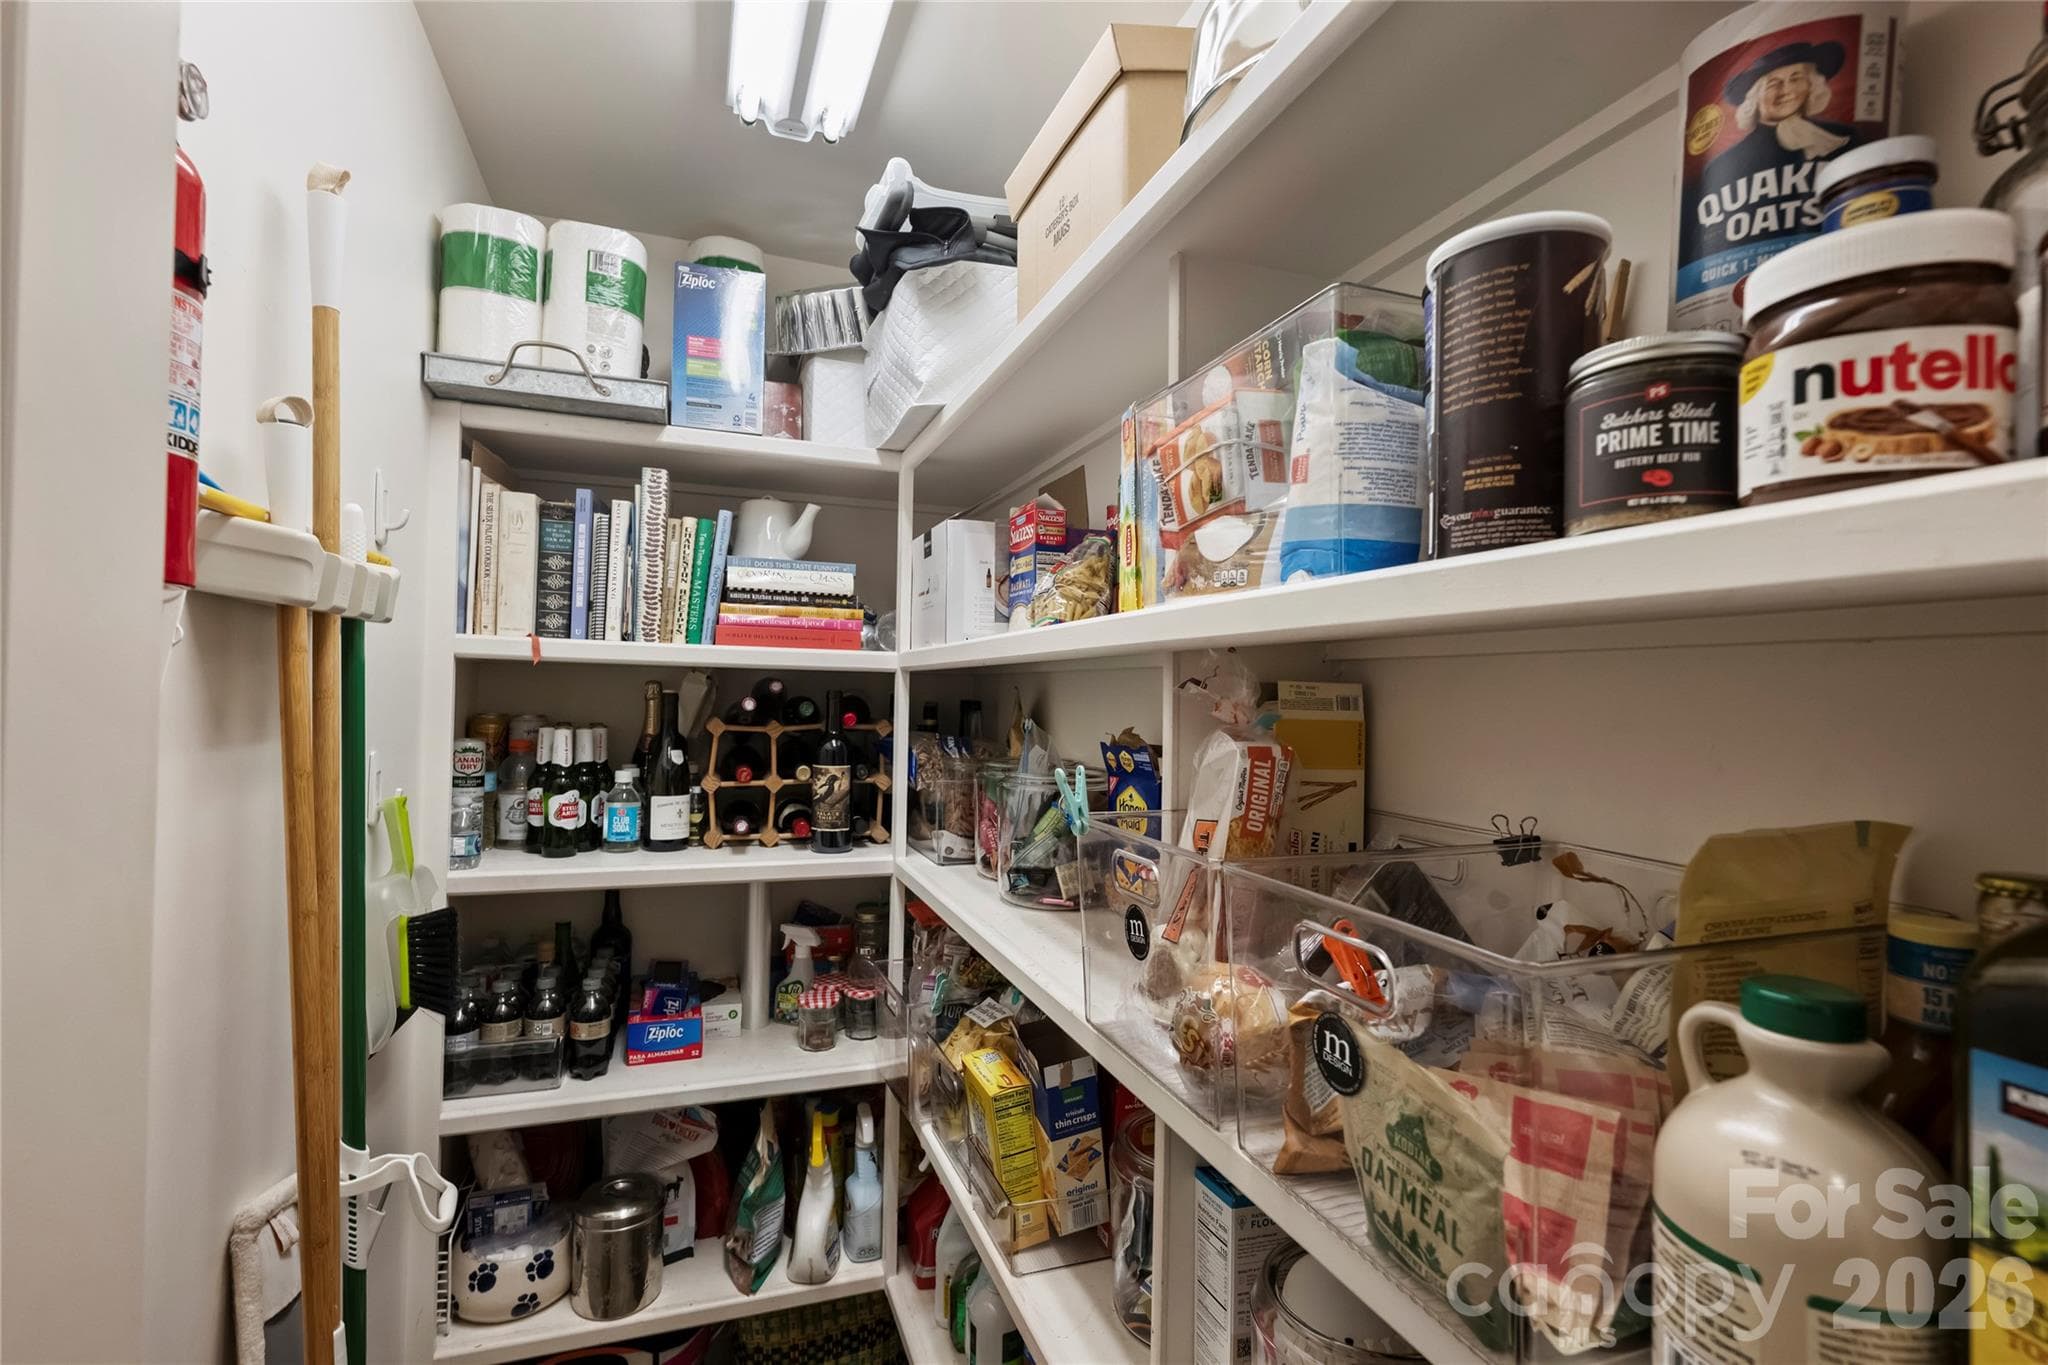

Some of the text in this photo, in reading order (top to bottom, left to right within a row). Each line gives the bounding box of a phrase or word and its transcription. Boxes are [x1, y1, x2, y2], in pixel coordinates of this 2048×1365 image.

[1697, 161, 1831, 227] QUAK
[1726, 198, 1827, 241] OATS
[680, 272, 717, 289] Ziploc
[1701, 260, 1737, 283] QUICK
[1262, 341, 1273, 380] CORN
[1600, 401, 1716, 430] Butchers Blend
[1596, 421, 1720, 456] PRIME TIME
[1614, 455, 1655, 469] BUTTERY
[1657, 452, 1680, 464] BEEF
[483, 546, 491, 578] COOKBOOK
[610, 503, 621, 600] SOUTHERN COOKING
[688, 579, 702, 631] MASTERS
[1246, 759, 1272, 832] ORIGINAL
[505, 809, 527, 820] ZER
[613, 816, 630, 825] CLUB
[1120, 818, 1140, 831] Maid
[612, 825, 630, 833] SODA
[1923, 987, 1942, 1007] 15
[648, 1024, 684, 1042] Ziploc
[647, 1049, 684, 1058] ALMACENAR
[1323, 1030, 1352, 1067] m
[1322, 1052, 1353, 1077] DESIGN
[1055, 1112, 1097, 1130] thin crisps
[1393, 1132, 1432, 1173] KODIAK
[1066, 1181, 1098, 1197] original
[1362, 1146, 1463, 1257] OATMEAL
